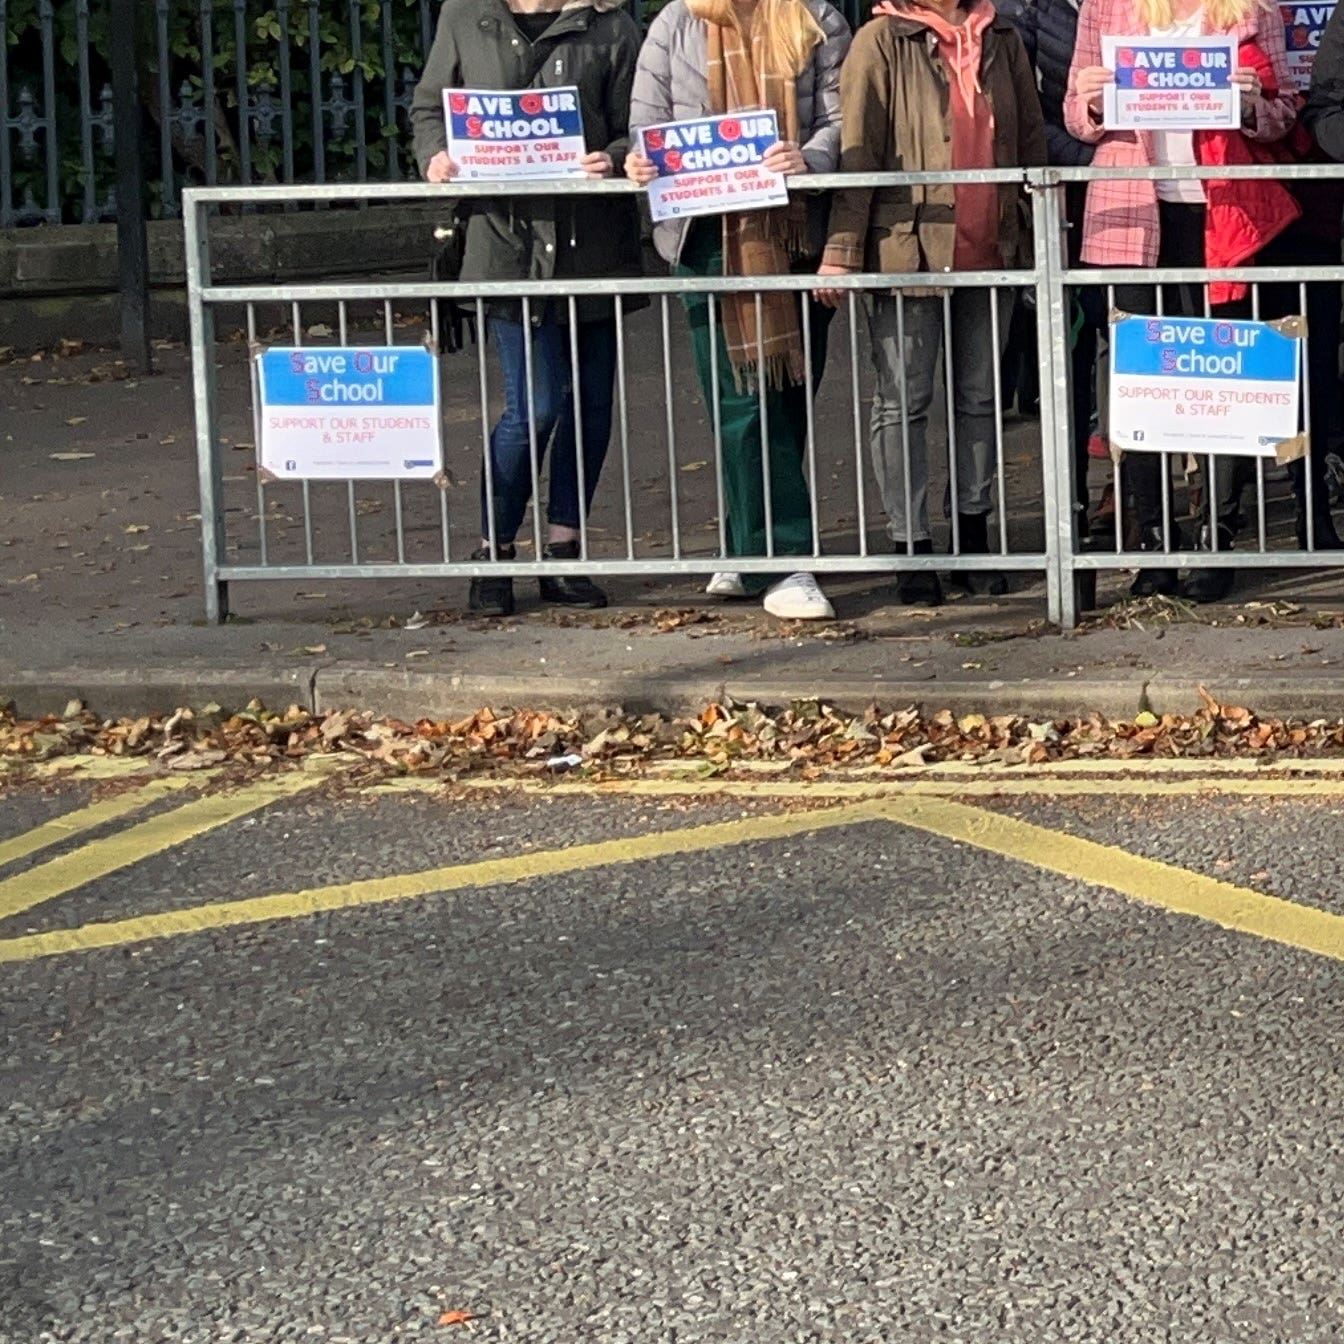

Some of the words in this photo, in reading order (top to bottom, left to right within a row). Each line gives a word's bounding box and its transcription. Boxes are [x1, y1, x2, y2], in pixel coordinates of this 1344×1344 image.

[1118, 48, 1175, 68] SAVE
[1182, 50, 1227, 68] OUR
[1132, 69, 1215, 88] SCHOOL
[451, 93, 513, 115] SAVE
[520, 94, 576, 114] OUR
[466, 116, 563, 138] SCHOOL
[646, 125, 713, 150] SAVE
[718, 118, 774, 141] OUR
[664, 143, 762, 171] SCHOOL
[1148, 320, 1204, 344] Save
[1215, 323, 1260, 347] Our
[291, 352, 346, 373] Save
[354, 352, 398, 373] Our
[1163, 350, 1241, 374] School
[307, 379, 383, 401] School
[1119, 387, 1179, 400] SUPPORT
[1185, 389, 1213, 401] OUR
[1219, 391, 1290, 405] STUDENTS
[1175, 406, 1184, 415] &
[1191, 406, 1231, 416] STAFF
[269, 417, 325, 429] SUPPORT
[331, 417, 357, 428] OUR
[363, 417, 430, 429] STUDENTS
[323, 433, 332, 443] &
[337, 432, 376, 443] STAFF
